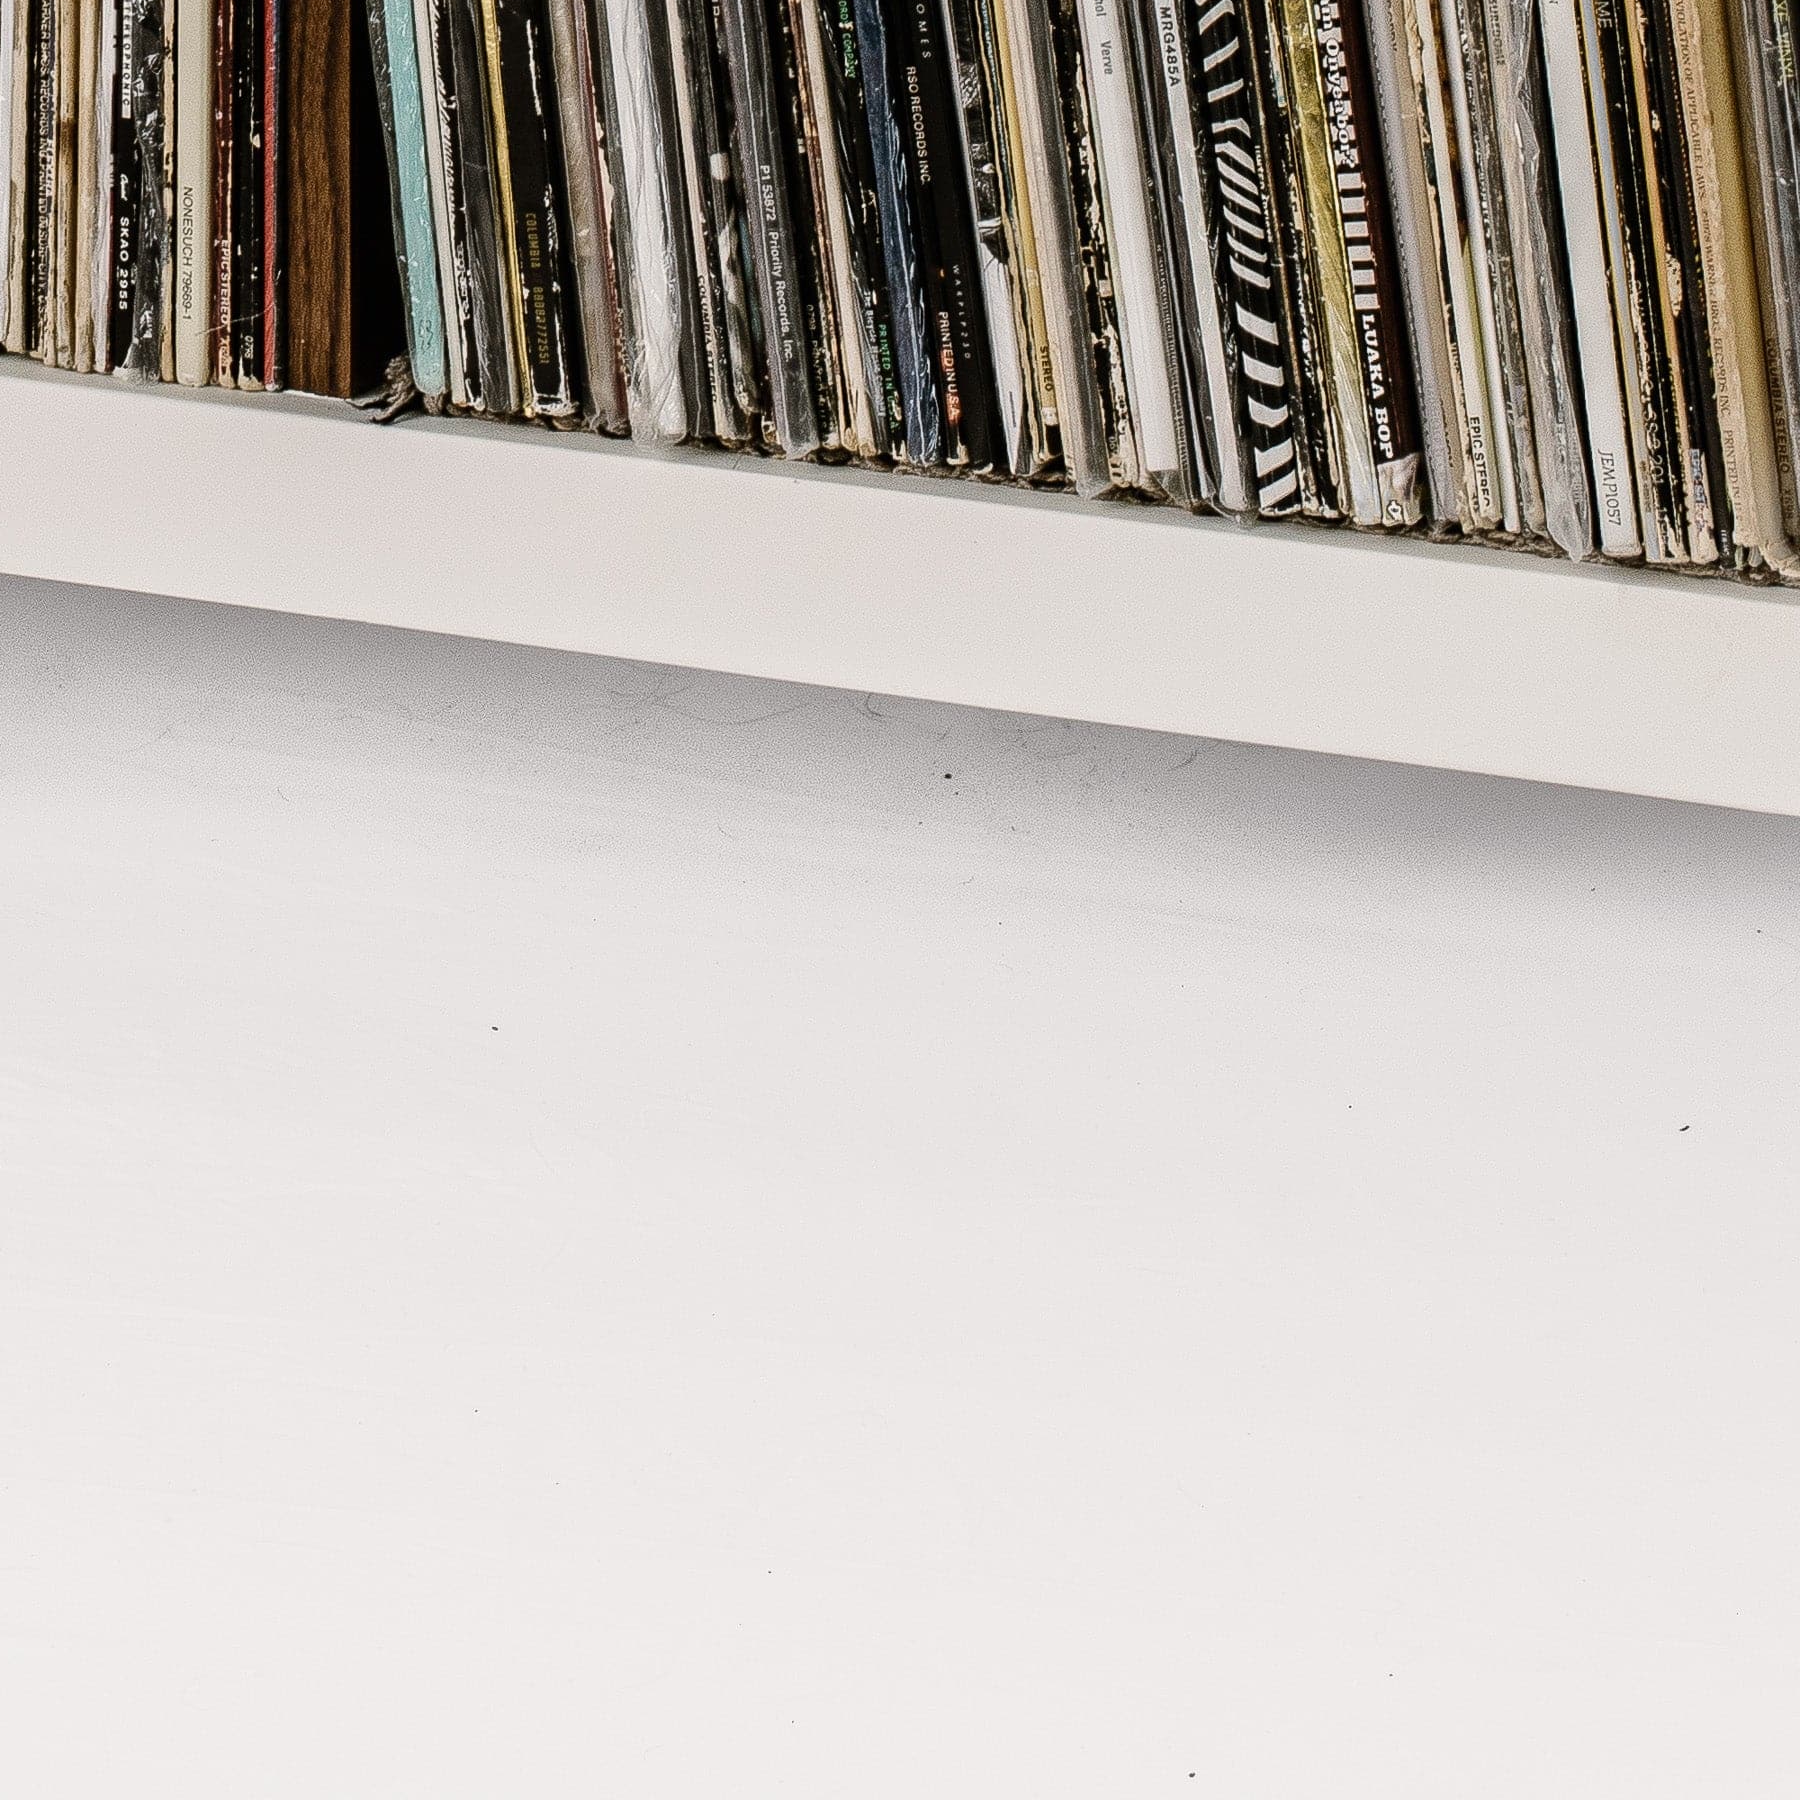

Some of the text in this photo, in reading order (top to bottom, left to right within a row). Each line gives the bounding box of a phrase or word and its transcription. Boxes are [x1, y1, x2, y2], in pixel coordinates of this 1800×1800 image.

[1160, 6, 1182, 86] MRG485A
[1322, 38, 1360, 168] Onyeabor?
[183, 187, 193, 266] NONESUCH
[181, 270, 193, 320] 79669-1
[1361, 314, 1393, 459] LUAKA BOP
[1597, 450, 1622, 525] JEMP1057
